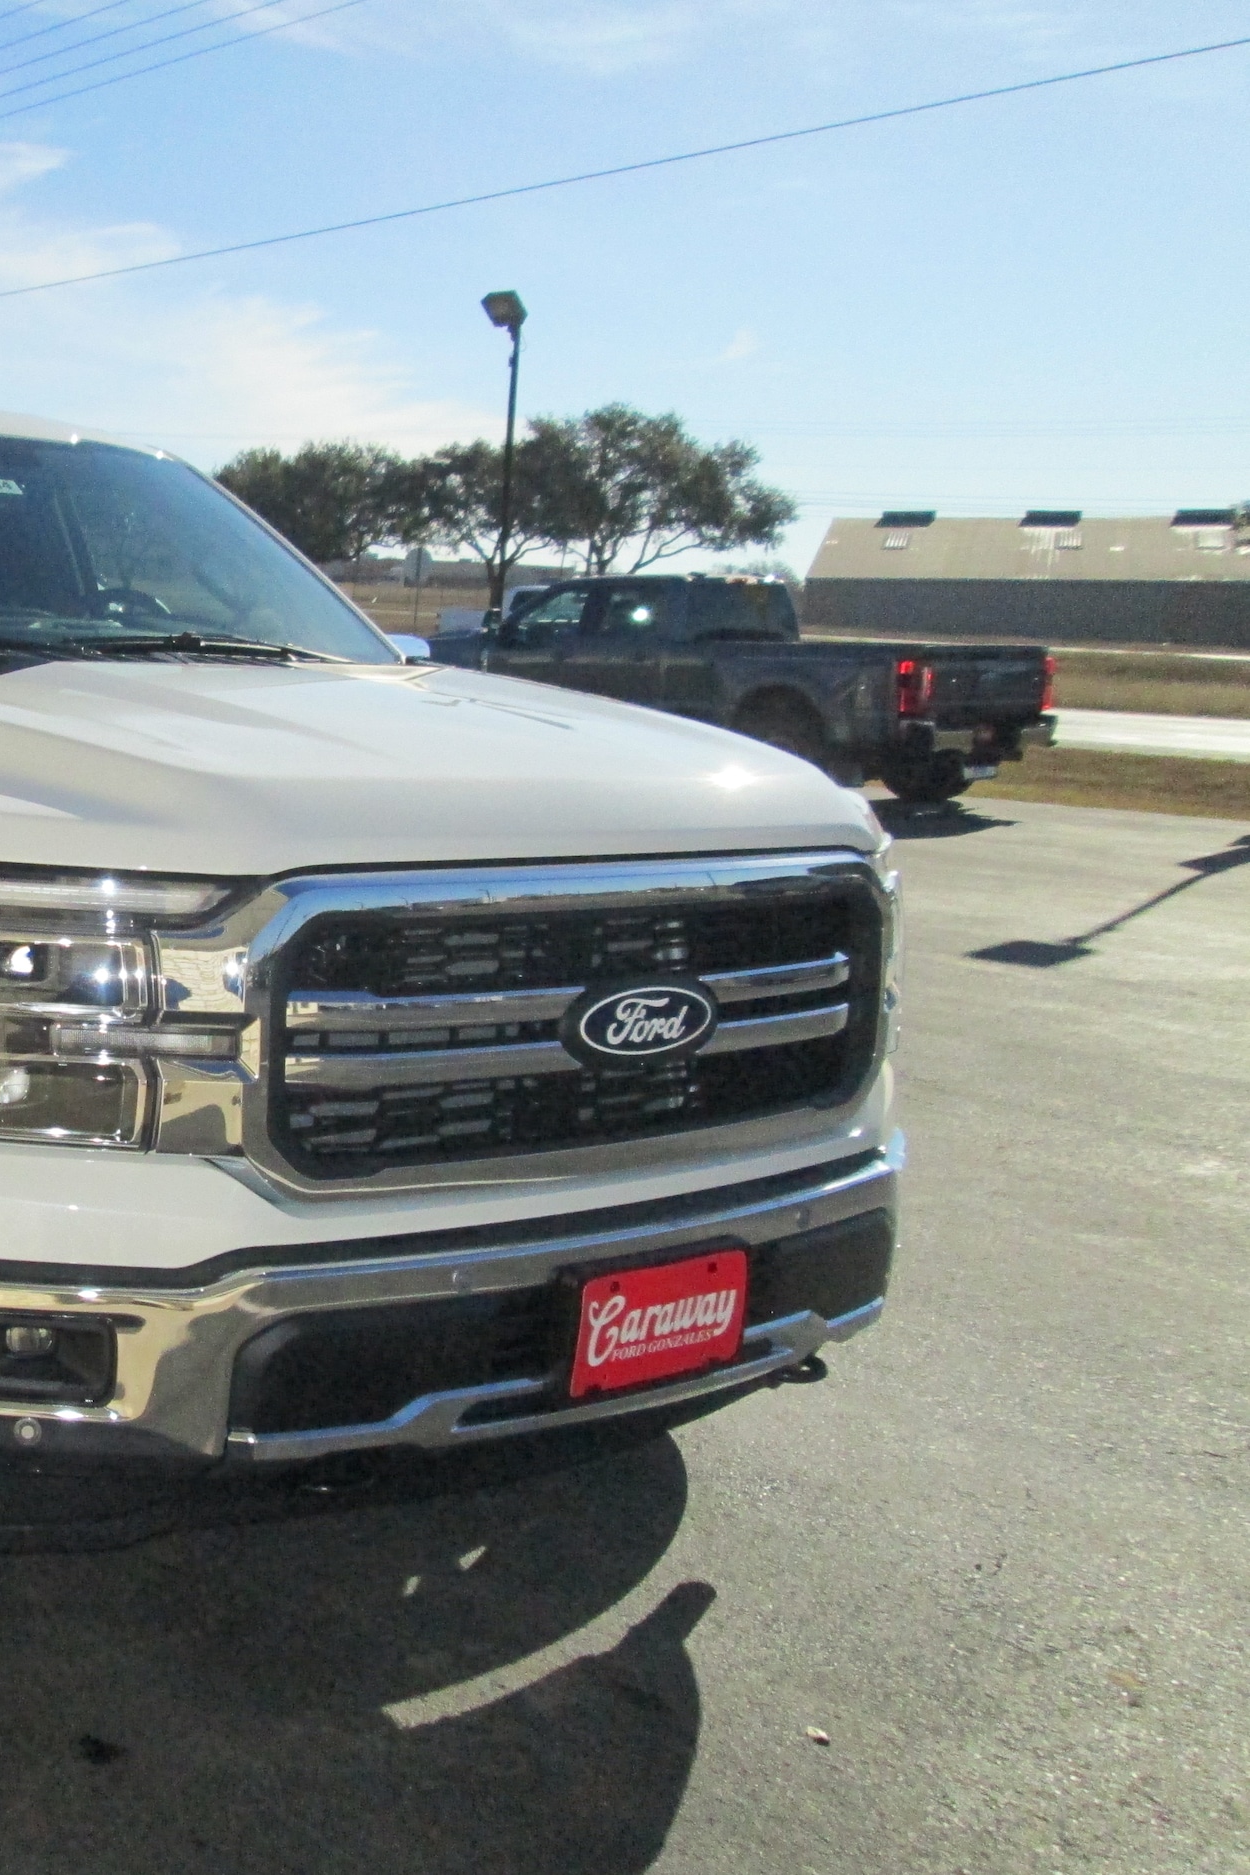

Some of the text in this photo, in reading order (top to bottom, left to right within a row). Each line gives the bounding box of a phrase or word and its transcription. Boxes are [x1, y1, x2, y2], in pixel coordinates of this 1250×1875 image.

[607, 997, 689, 1045] Ford
[587, 1289, 737, 1367] Caraway
[611, 1331, 713, 1361] FORD GONZALES
